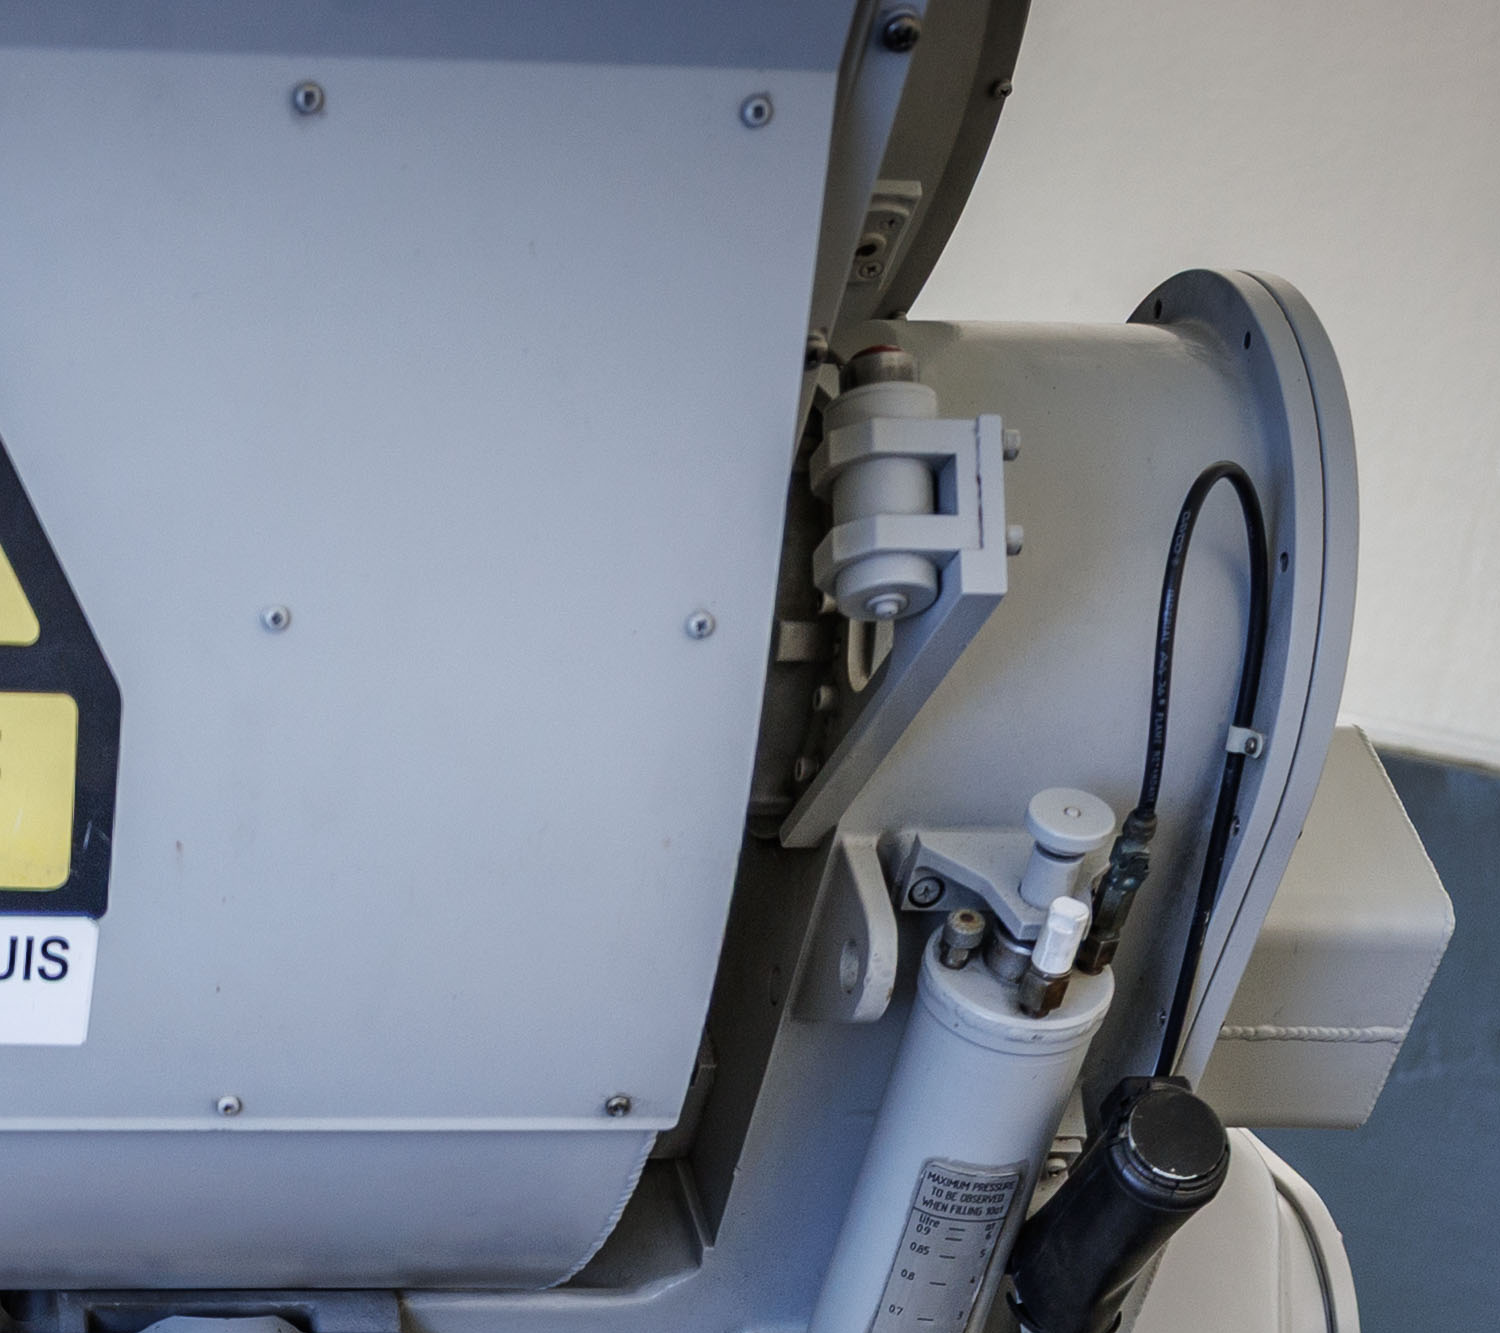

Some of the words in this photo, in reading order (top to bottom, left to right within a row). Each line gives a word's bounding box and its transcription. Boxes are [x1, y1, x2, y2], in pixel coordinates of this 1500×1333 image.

[927, 1171, 970, 1192] MAXIMUM
[972, 1181, 1016, 1192] PRESSURE
[931, 1186, 943, 1198] TO
[946, 1191, 958, 1201] BE
[959, 1193, 1005, 1204] OBSERVED
[922, 1197, 949, 1213] WHEN
[950, 1204, 982, 1217] FILLING
